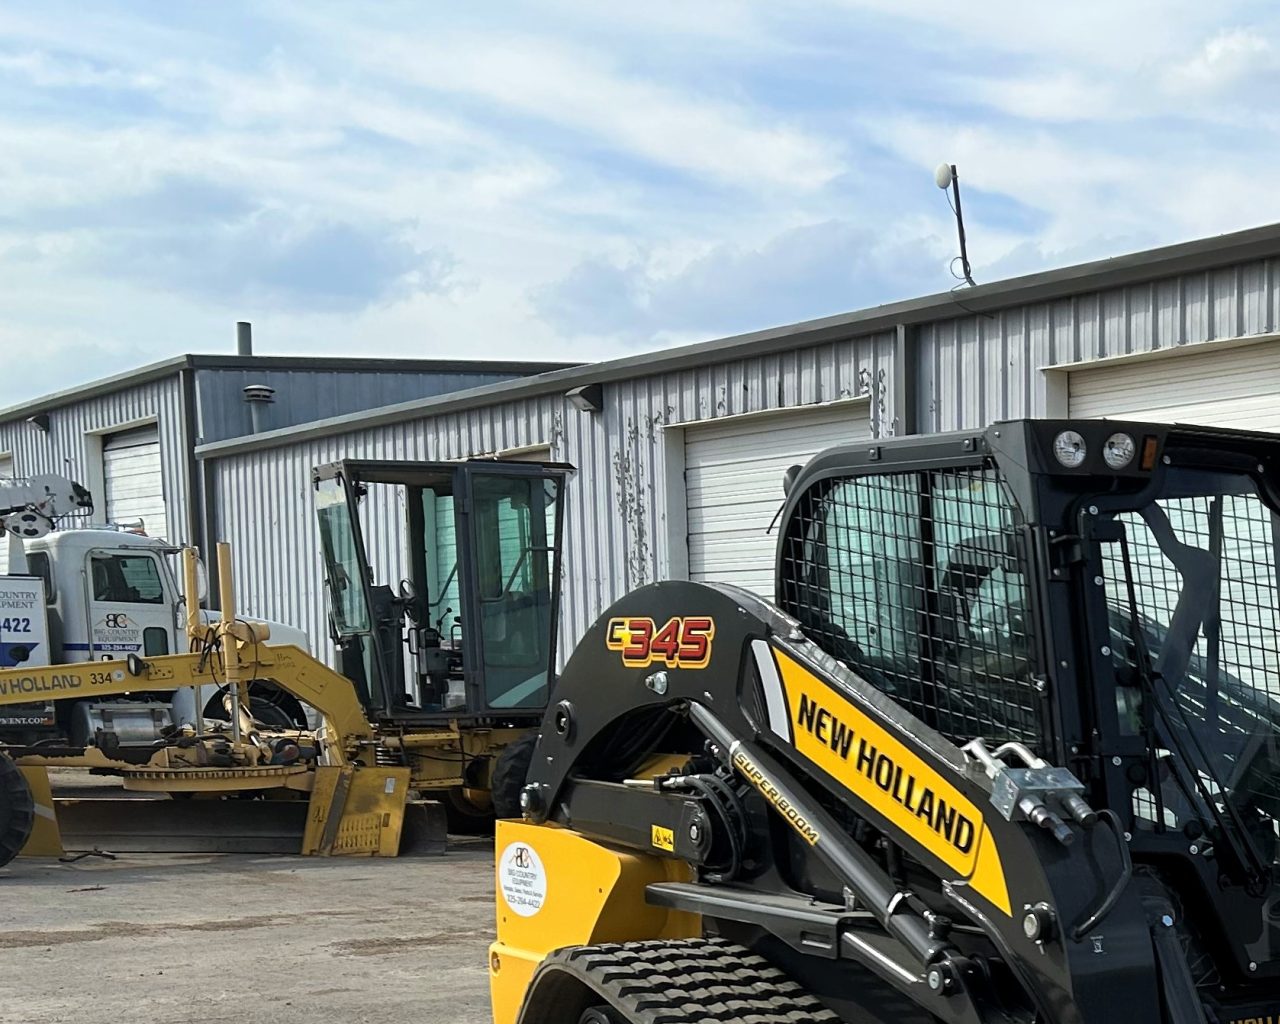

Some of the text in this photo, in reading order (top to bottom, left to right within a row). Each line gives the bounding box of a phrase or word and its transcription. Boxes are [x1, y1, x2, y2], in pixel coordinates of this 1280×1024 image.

[0, 617, 31, 632] 422
[10, 675, 81, 694] HOLLAND
[90, 673, 112, 685] 334
[798, 693, 974, 854] NEW HOLLAND
